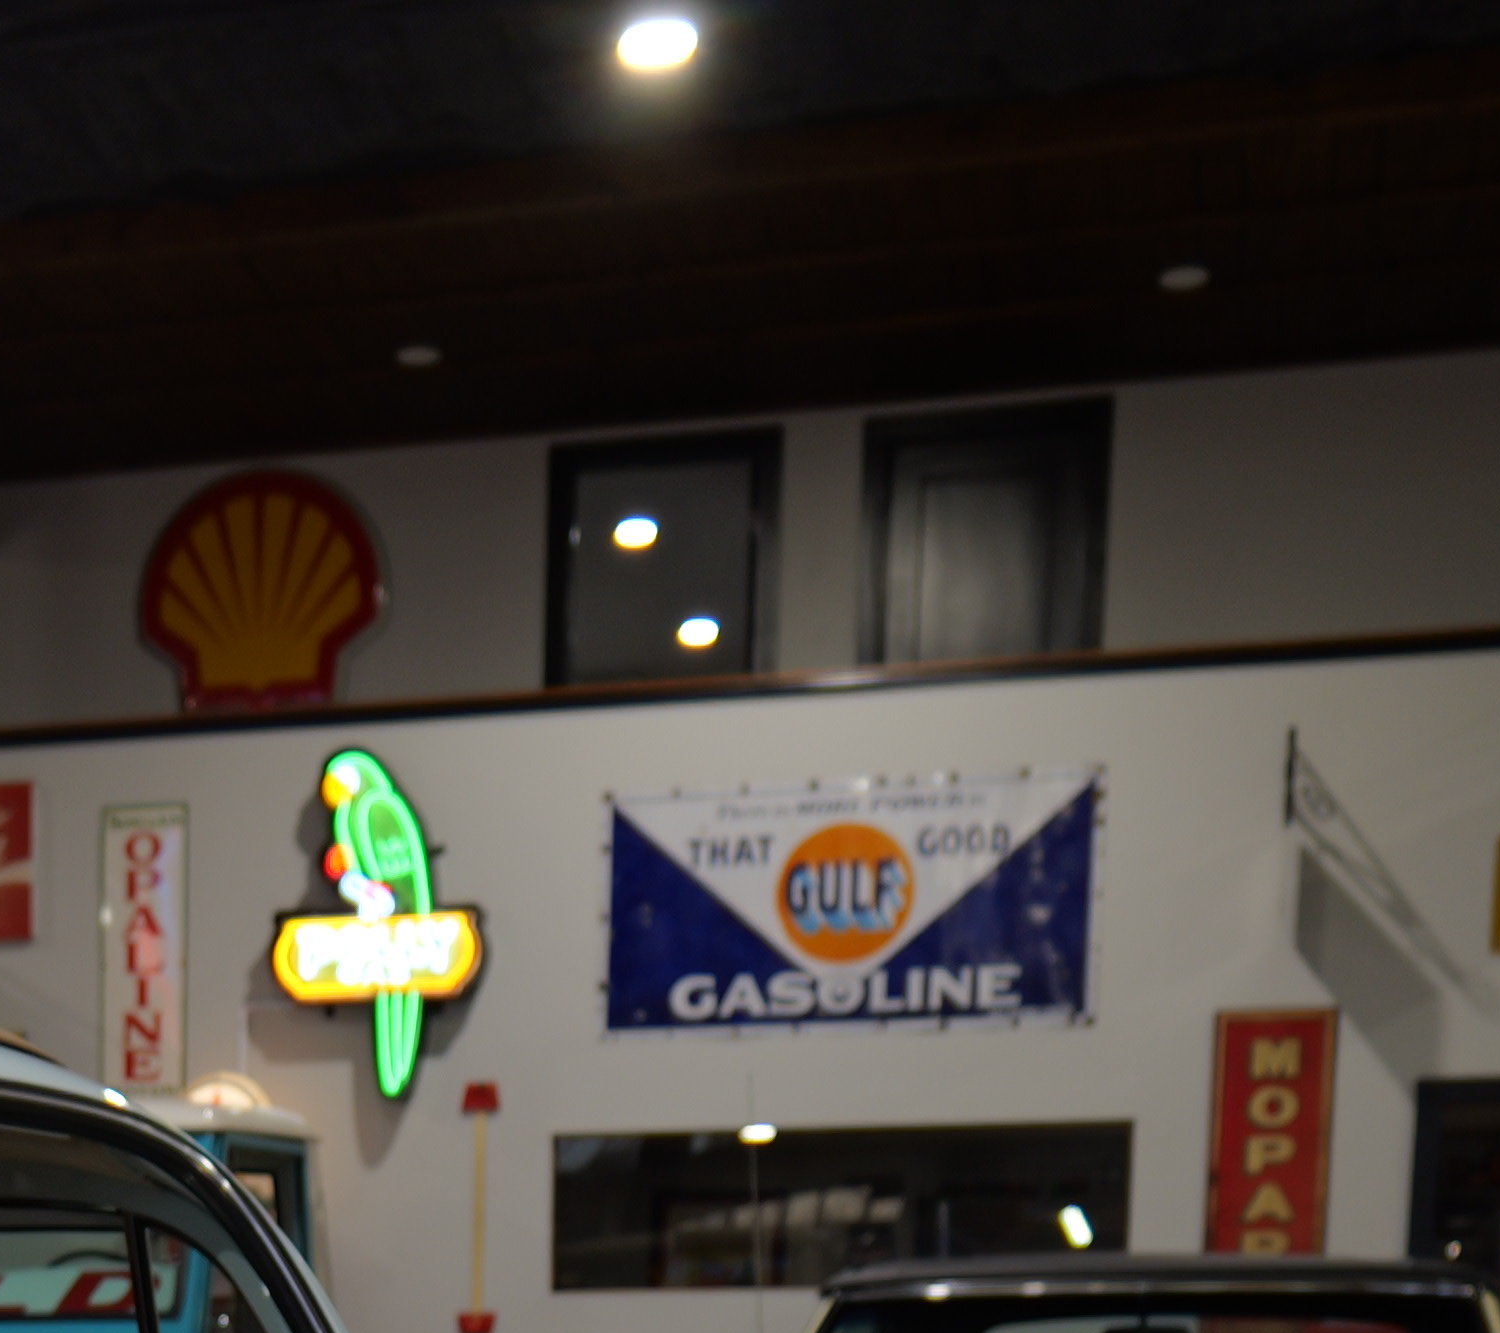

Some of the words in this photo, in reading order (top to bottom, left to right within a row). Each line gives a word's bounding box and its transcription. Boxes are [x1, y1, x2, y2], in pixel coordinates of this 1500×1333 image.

[689, 834, 776, 867] THAT
[918, 823, 1012, 857] GOOD
[786, 856, 904, 925] GULF
[123, 829, 164, 1083] OPALINE
[668, 962, 1023, 1022] GASOLINE
